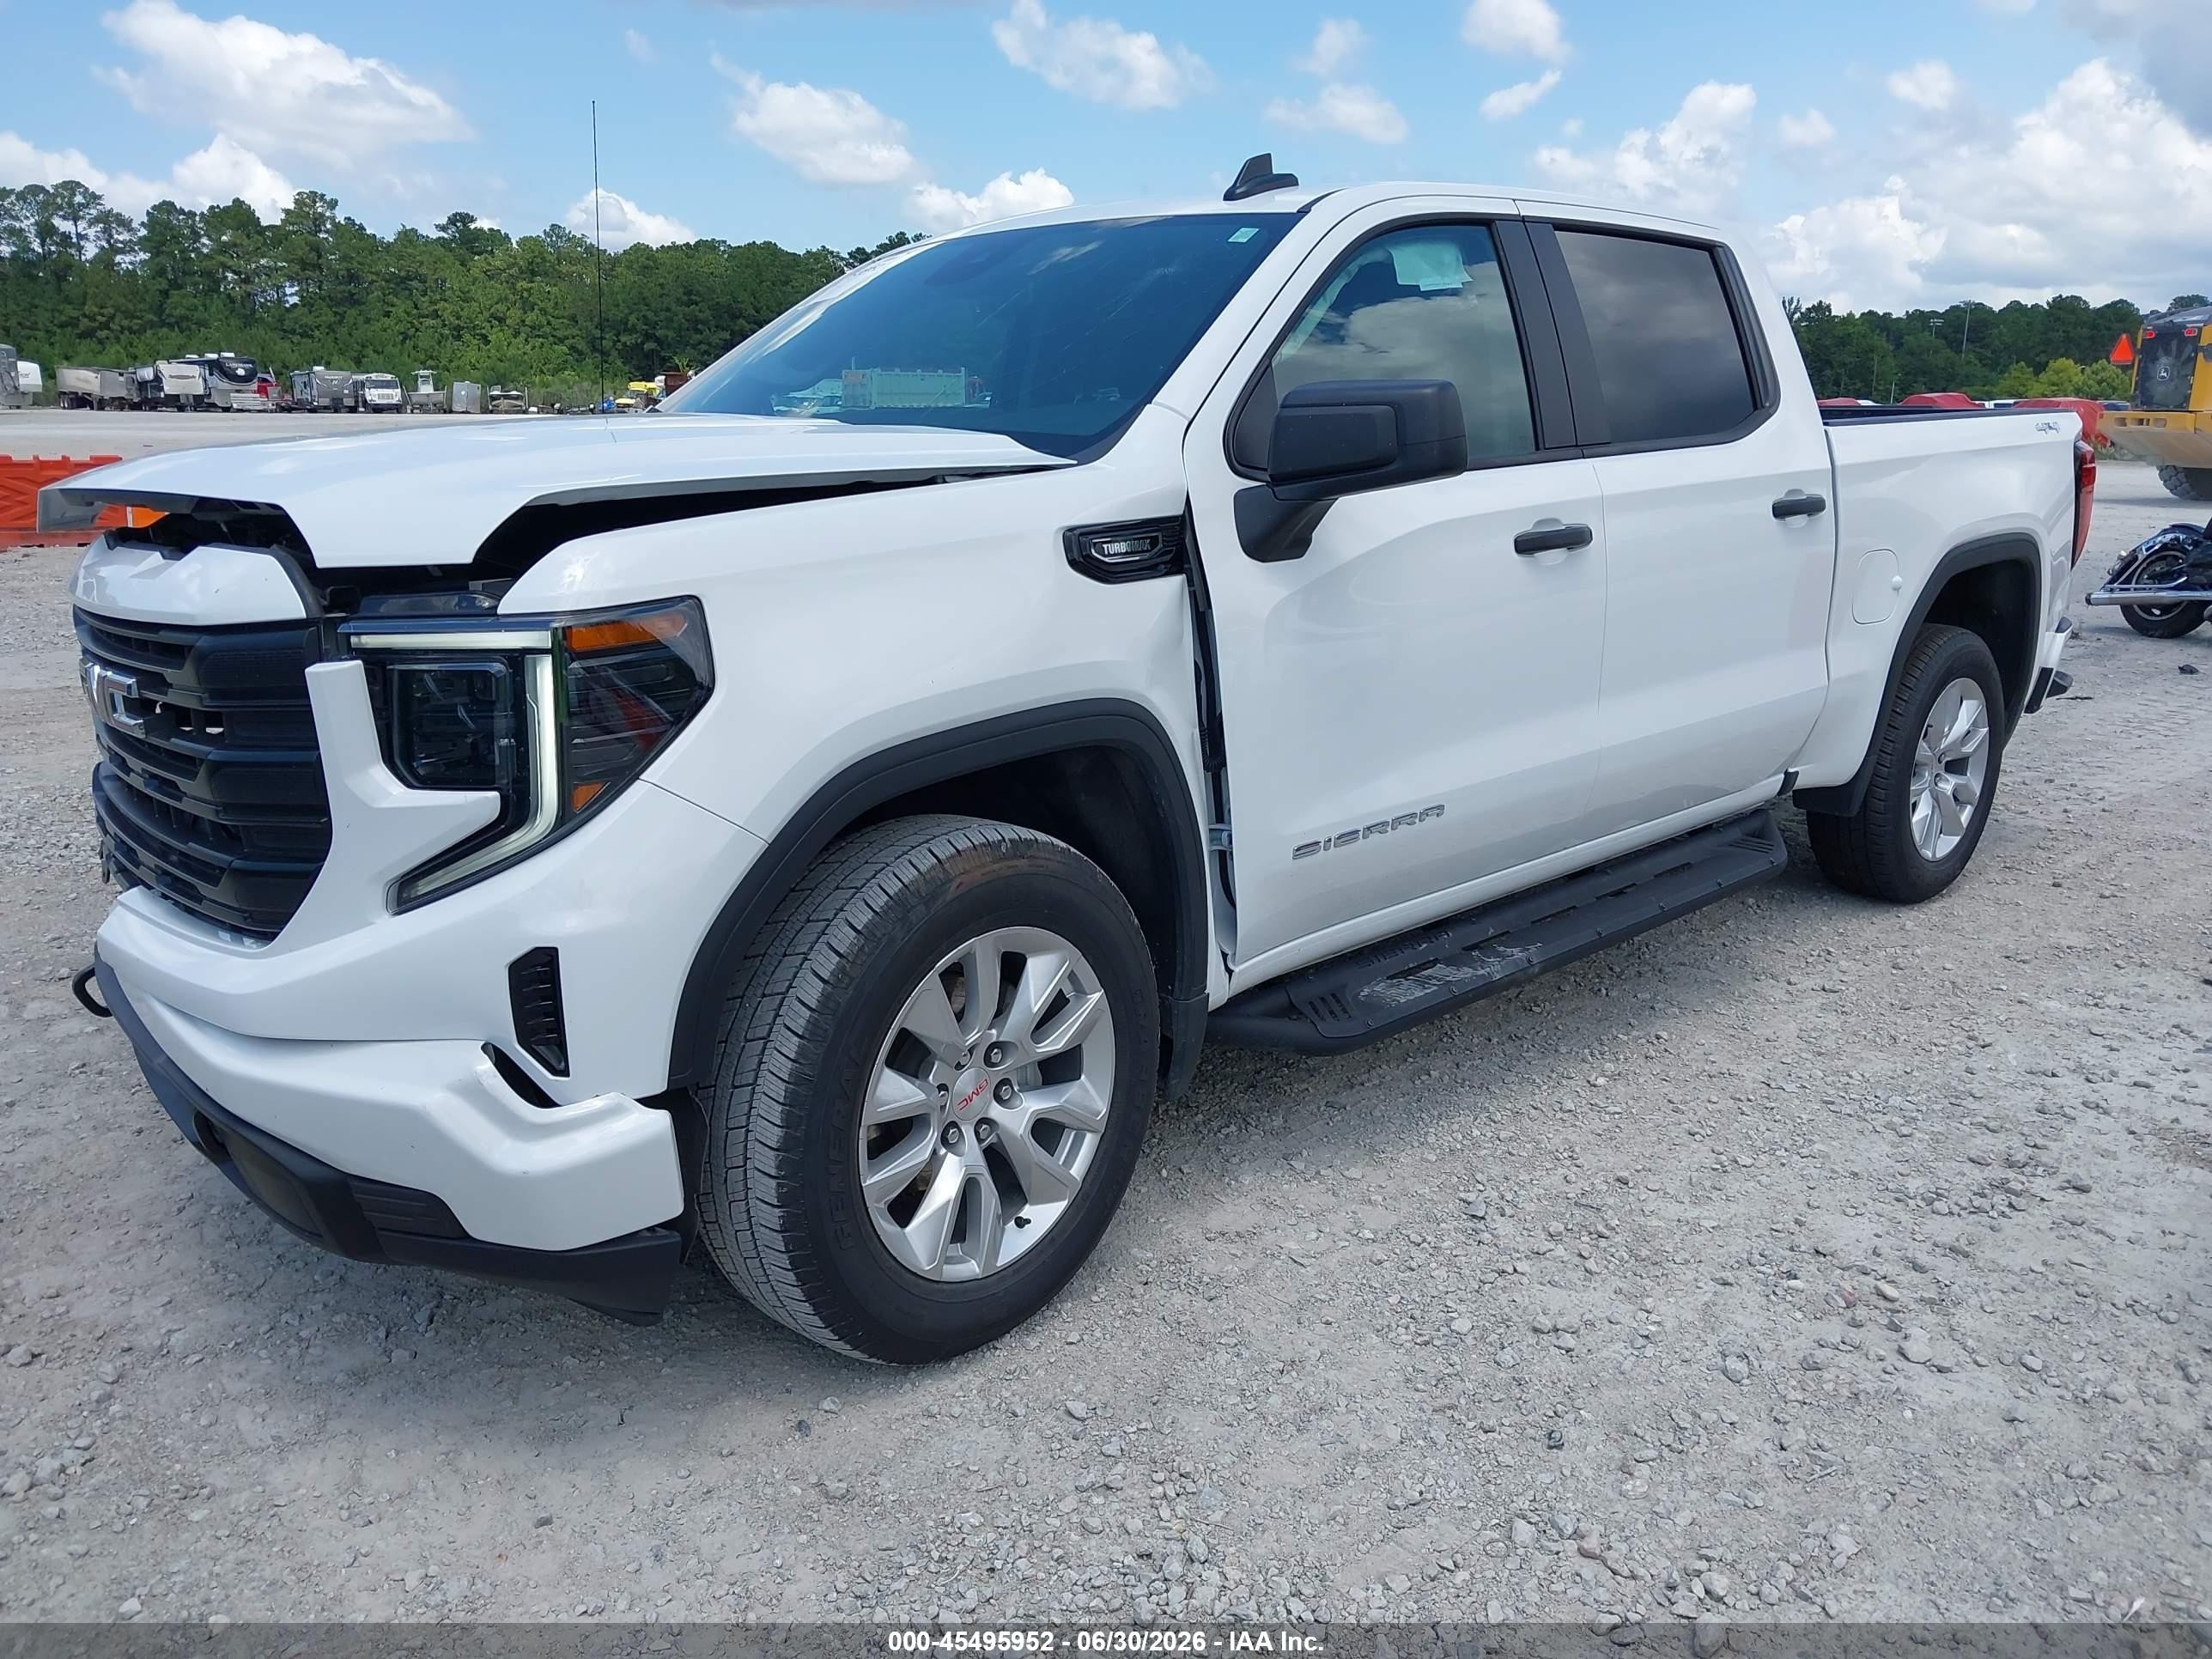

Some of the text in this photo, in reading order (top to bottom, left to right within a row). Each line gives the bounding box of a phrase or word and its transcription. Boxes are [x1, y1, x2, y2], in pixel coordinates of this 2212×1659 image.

[1102, 538, 1152, 556] TURBOMAX
[1291, 803, 1446, 860] SIERRA
[957, 1078, 988, 1111] GMC
